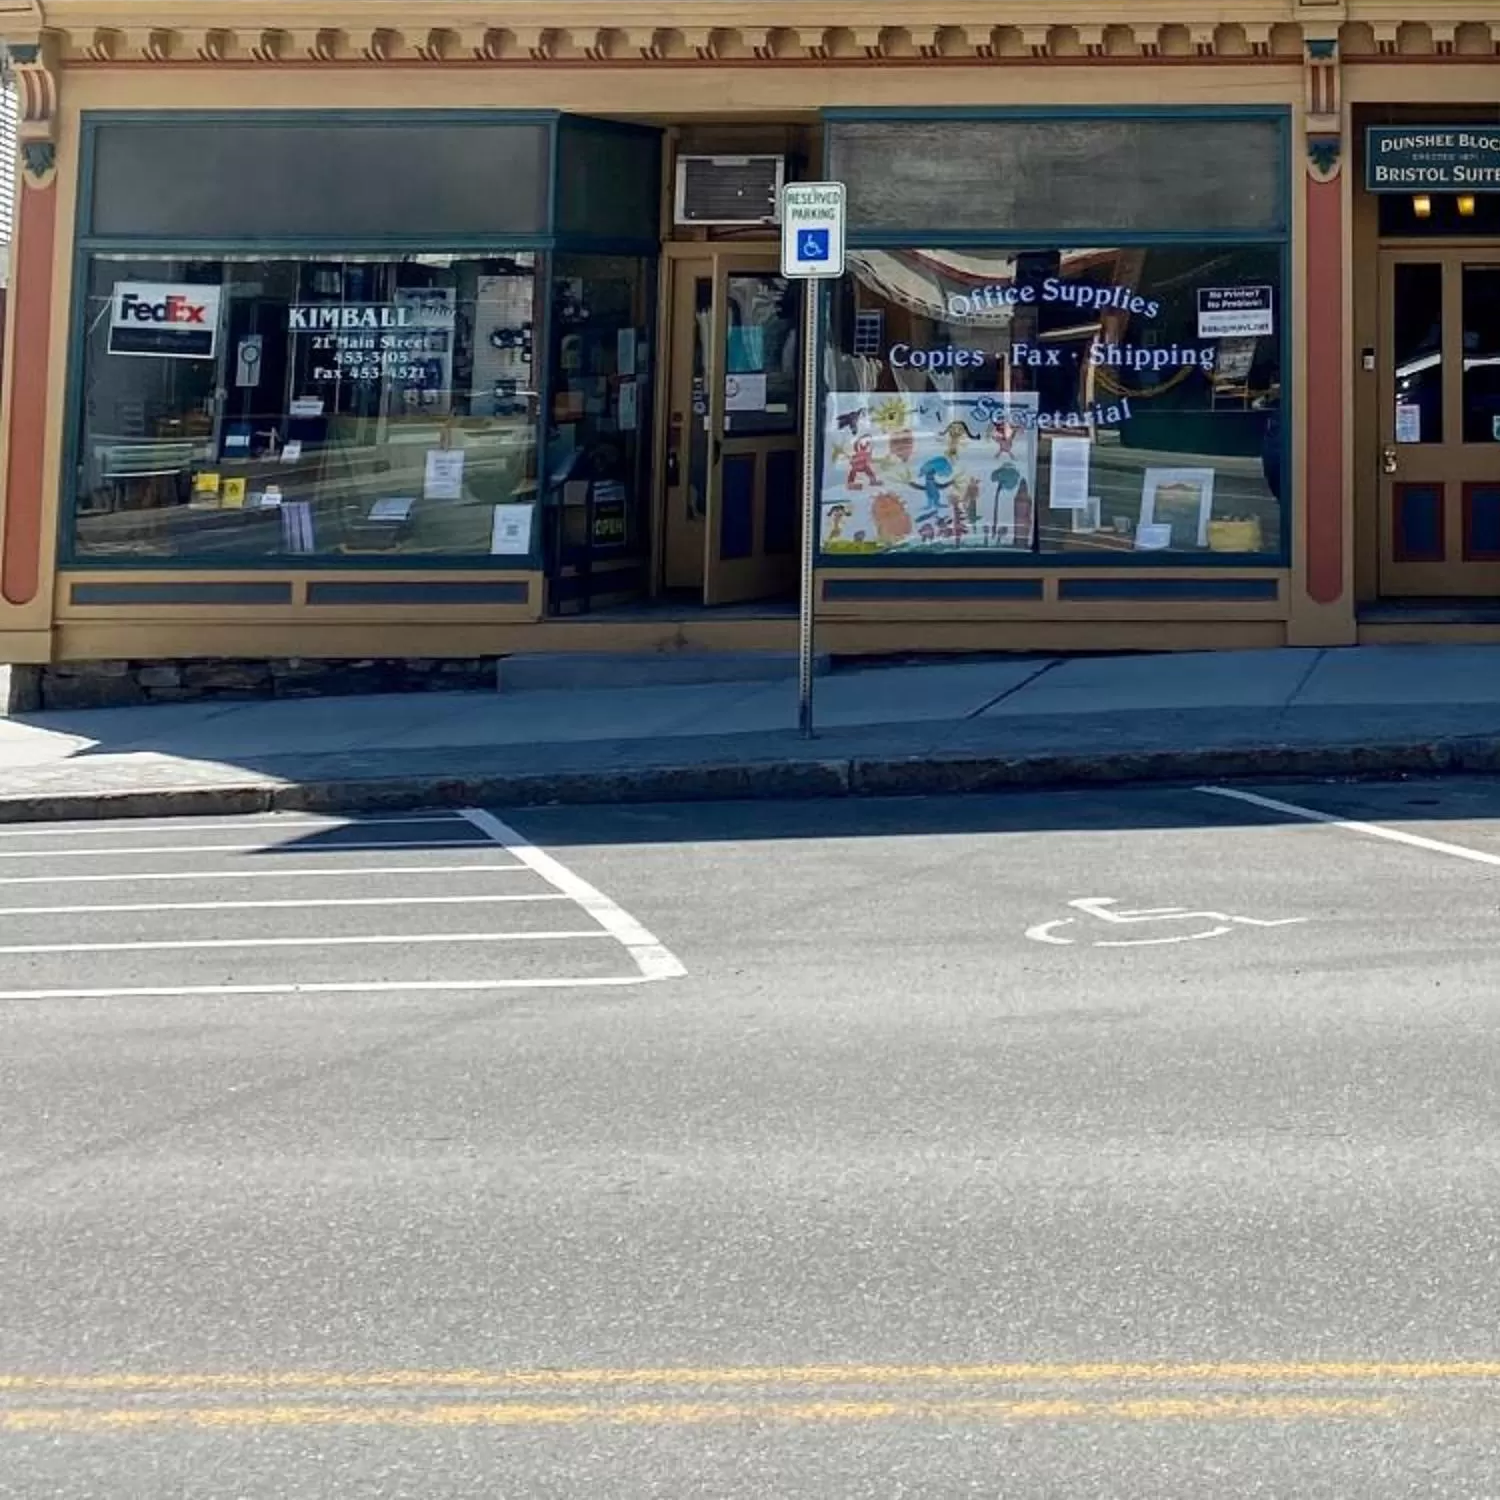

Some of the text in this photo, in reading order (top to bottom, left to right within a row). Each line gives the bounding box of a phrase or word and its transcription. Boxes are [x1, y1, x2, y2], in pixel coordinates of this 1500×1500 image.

[1381, 135, 1455, 153] DUNSHEE
[1375, 165, 1449, 182] BRISTOL
[787, 191, 841, 205] RESERVED
[791, 207, 836, 220] PARKING
[949, 277, 1160, 319] Office Supplies
[121, 293, 206, 323] FedEx
[288, 307, 412, 329] KIMBALL
[312, 335, 430, 349] 21 Main Street
[889, 343, 1217, 372] Copies Fax Shipping
[313, 367, 342, 379] Fax
[971, 396, 1133, 430] Secretarial
